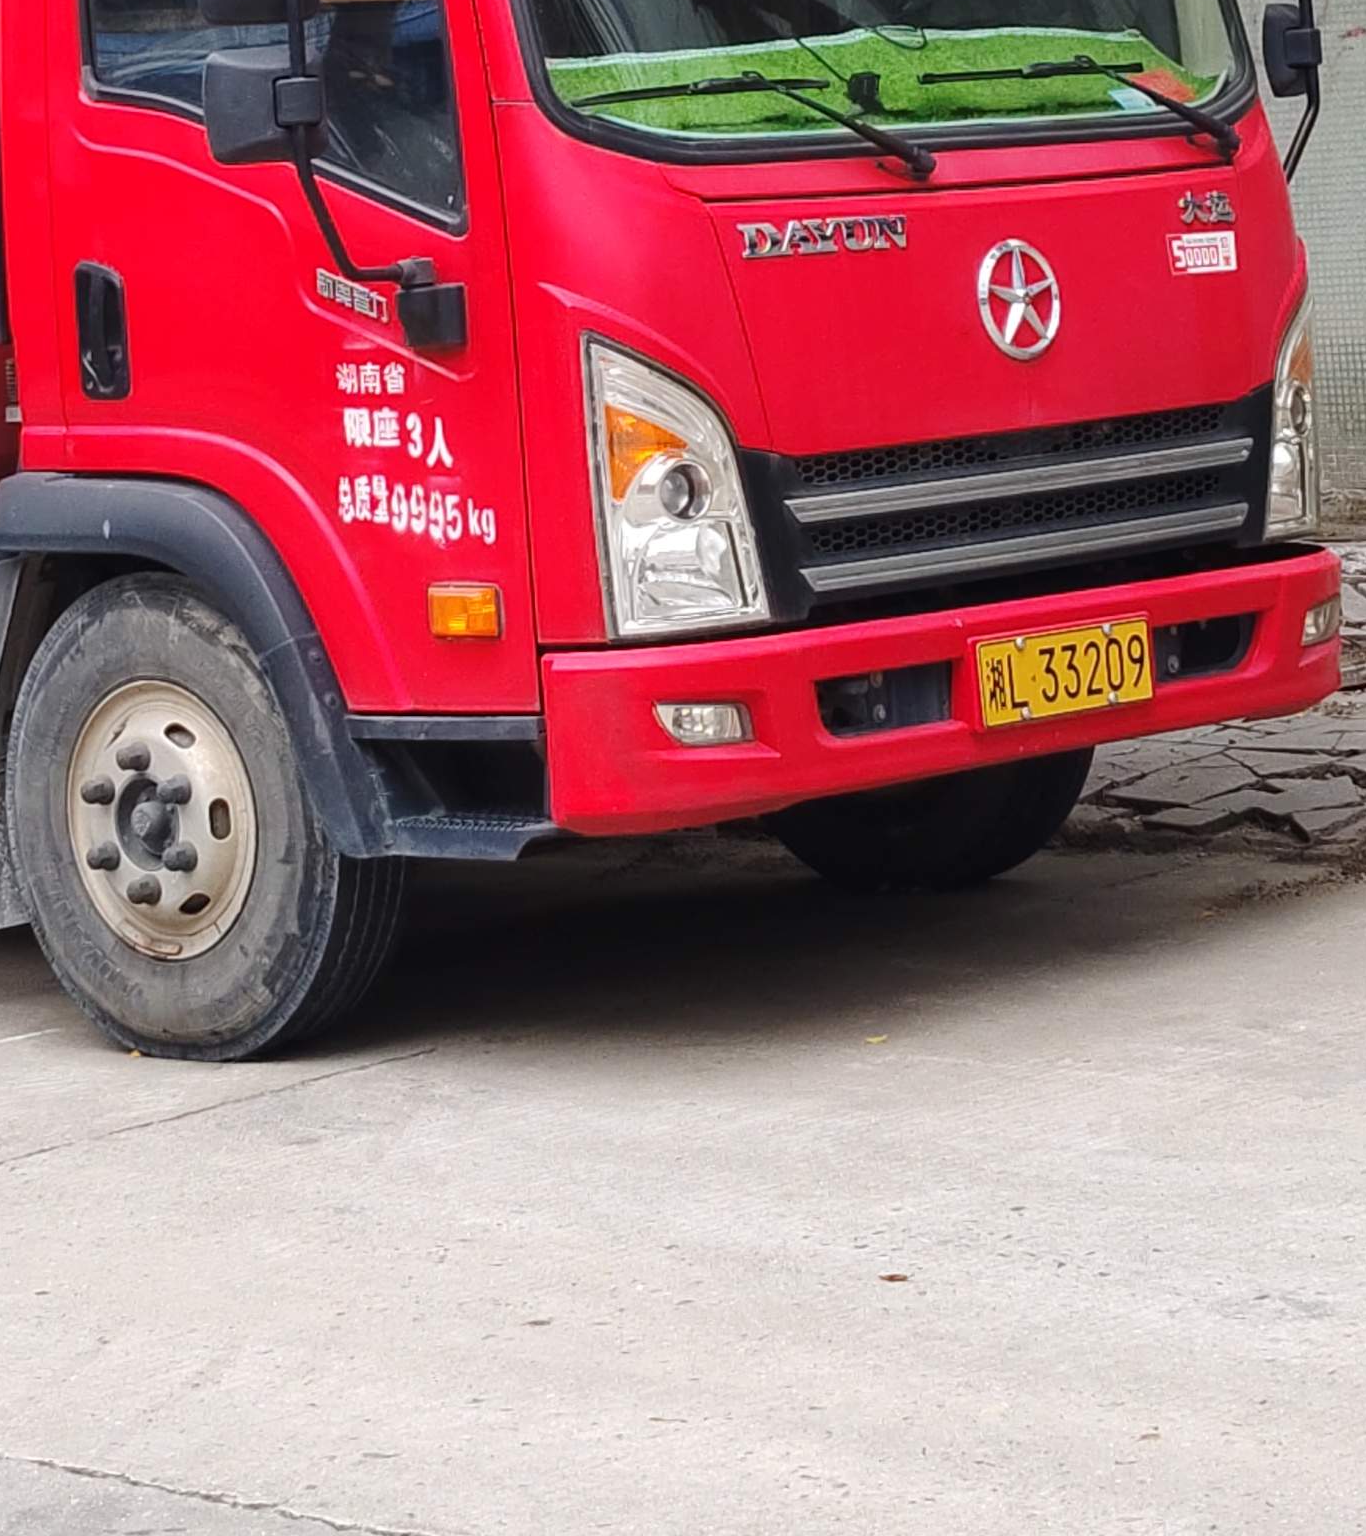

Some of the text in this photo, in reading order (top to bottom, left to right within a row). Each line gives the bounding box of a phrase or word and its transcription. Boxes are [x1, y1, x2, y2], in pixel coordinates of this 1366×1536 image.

[1177, 190, 1236, 224] 大运
[736, 214, 908, 258] DAYUN
[336, 362, 406, 395] 湖南省
